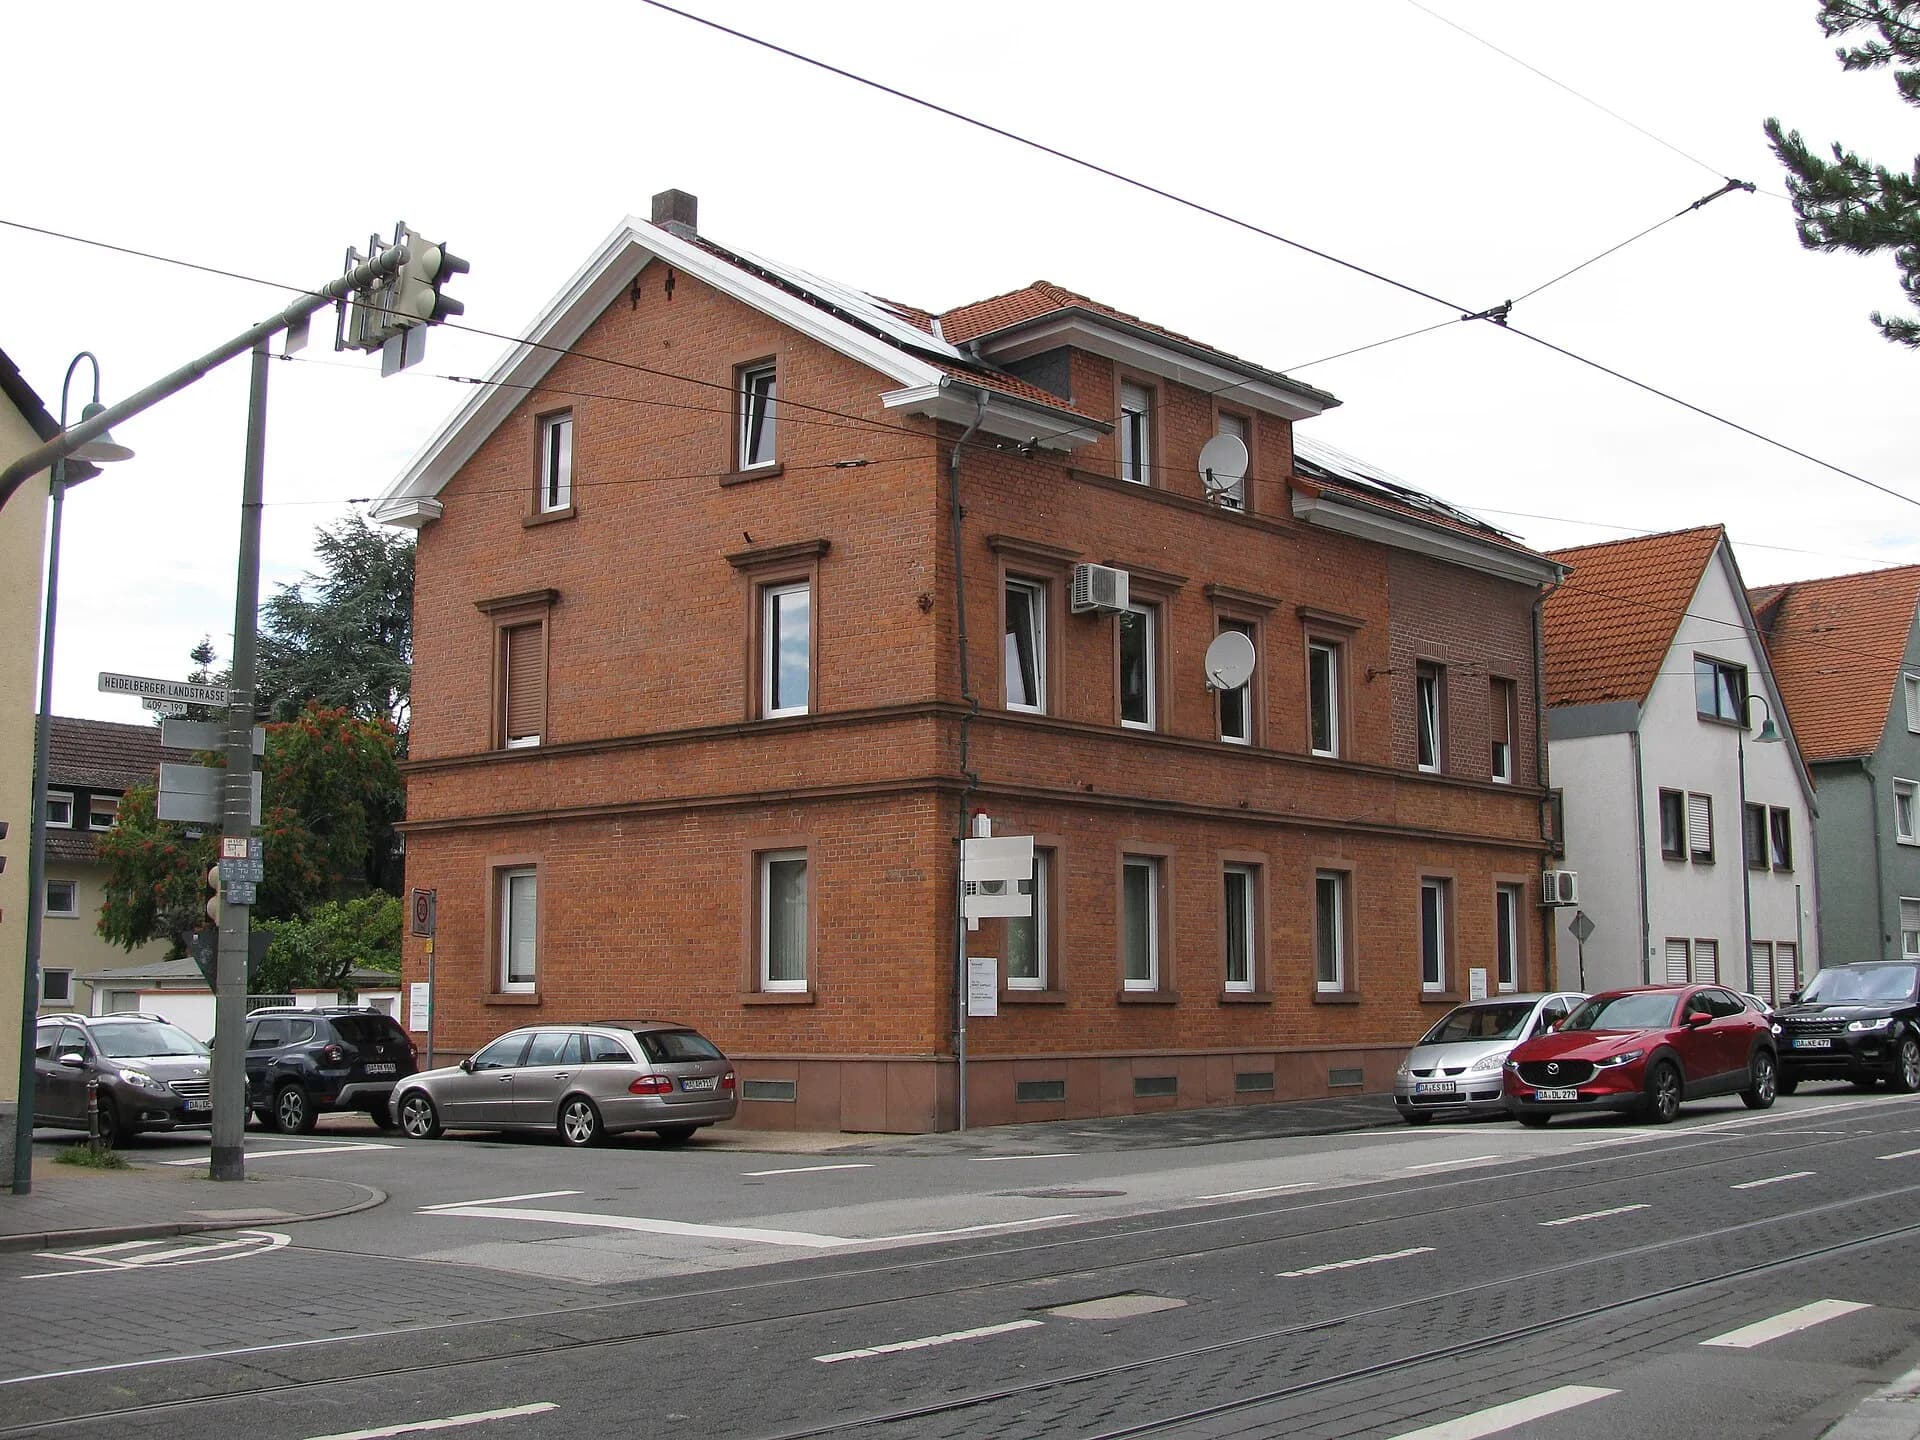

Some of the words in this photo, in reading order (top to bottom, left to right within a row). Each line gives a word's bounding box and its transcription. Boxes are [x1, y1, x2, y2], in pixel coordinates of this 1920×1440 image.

[104, 676, 166, 695] HEIDELBERGER
[168, 684, 225, 702] LANDSTRASSE
[146, 701, 162, 710] 409
[171, 703, 184, 712] 199
[1420, 1084, 1428, 1092] DA
[1539, 1091, 1548, 1099] DA
[1552, 1090, 1561, 1099] DL
[1562, 1090, 1576, 1099] 279
[190, 1101, 199, 1109] DA
